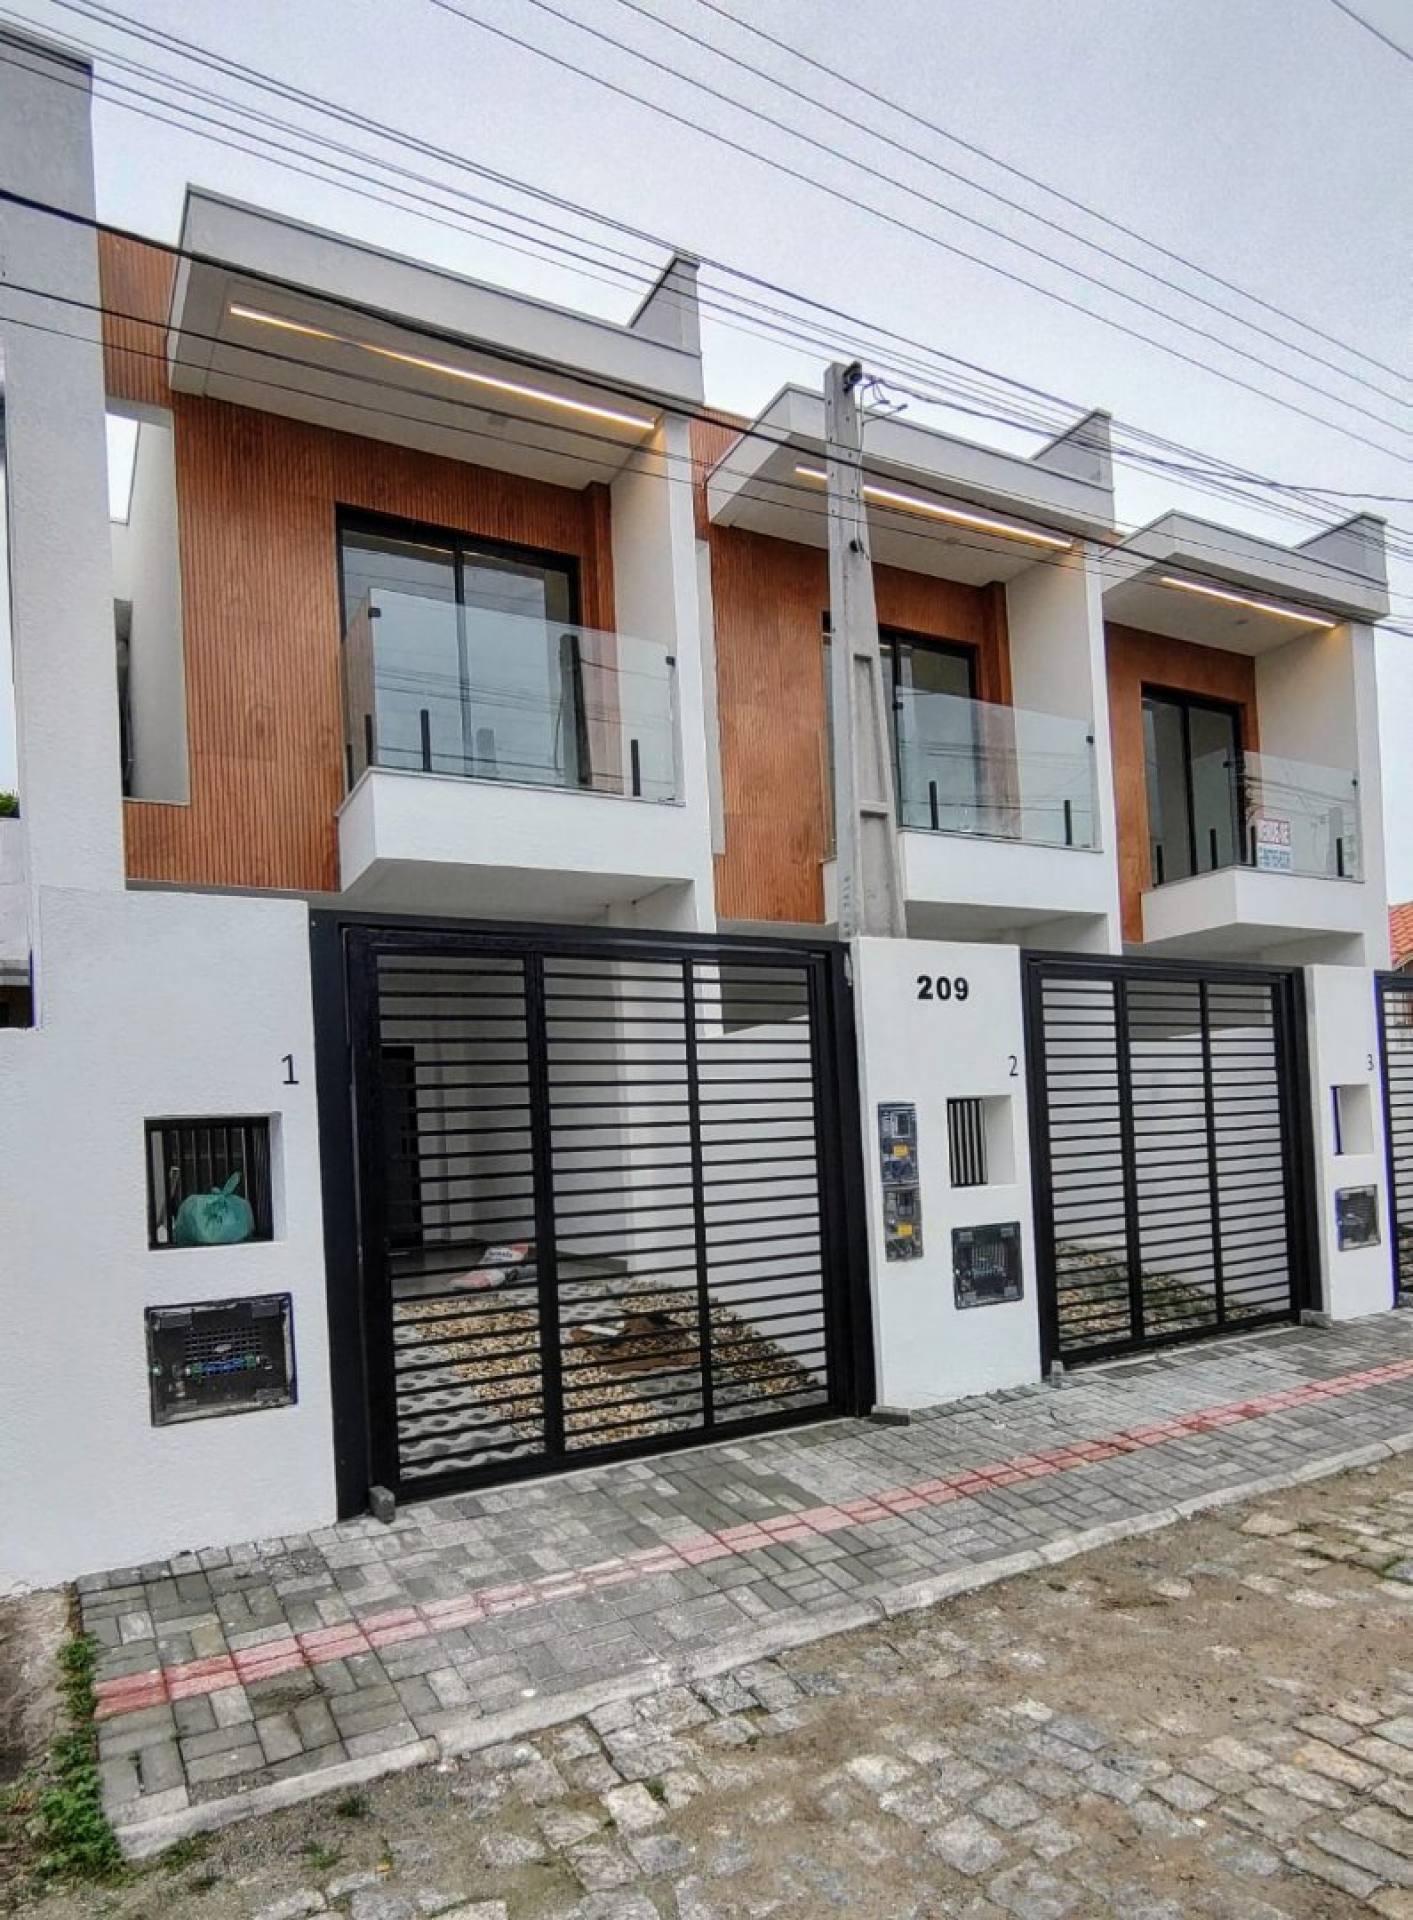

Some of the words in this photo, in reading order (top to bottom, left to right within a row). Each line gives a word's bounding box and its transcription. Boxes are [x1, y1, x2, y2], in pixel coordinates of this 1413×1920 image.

[916, 975, 970, 1001] 209
[281, 1053, 300, 1085] 1
[1007, 1055, 1019, 1077] 2
[1367, 1053, 1375, 1071] 3
